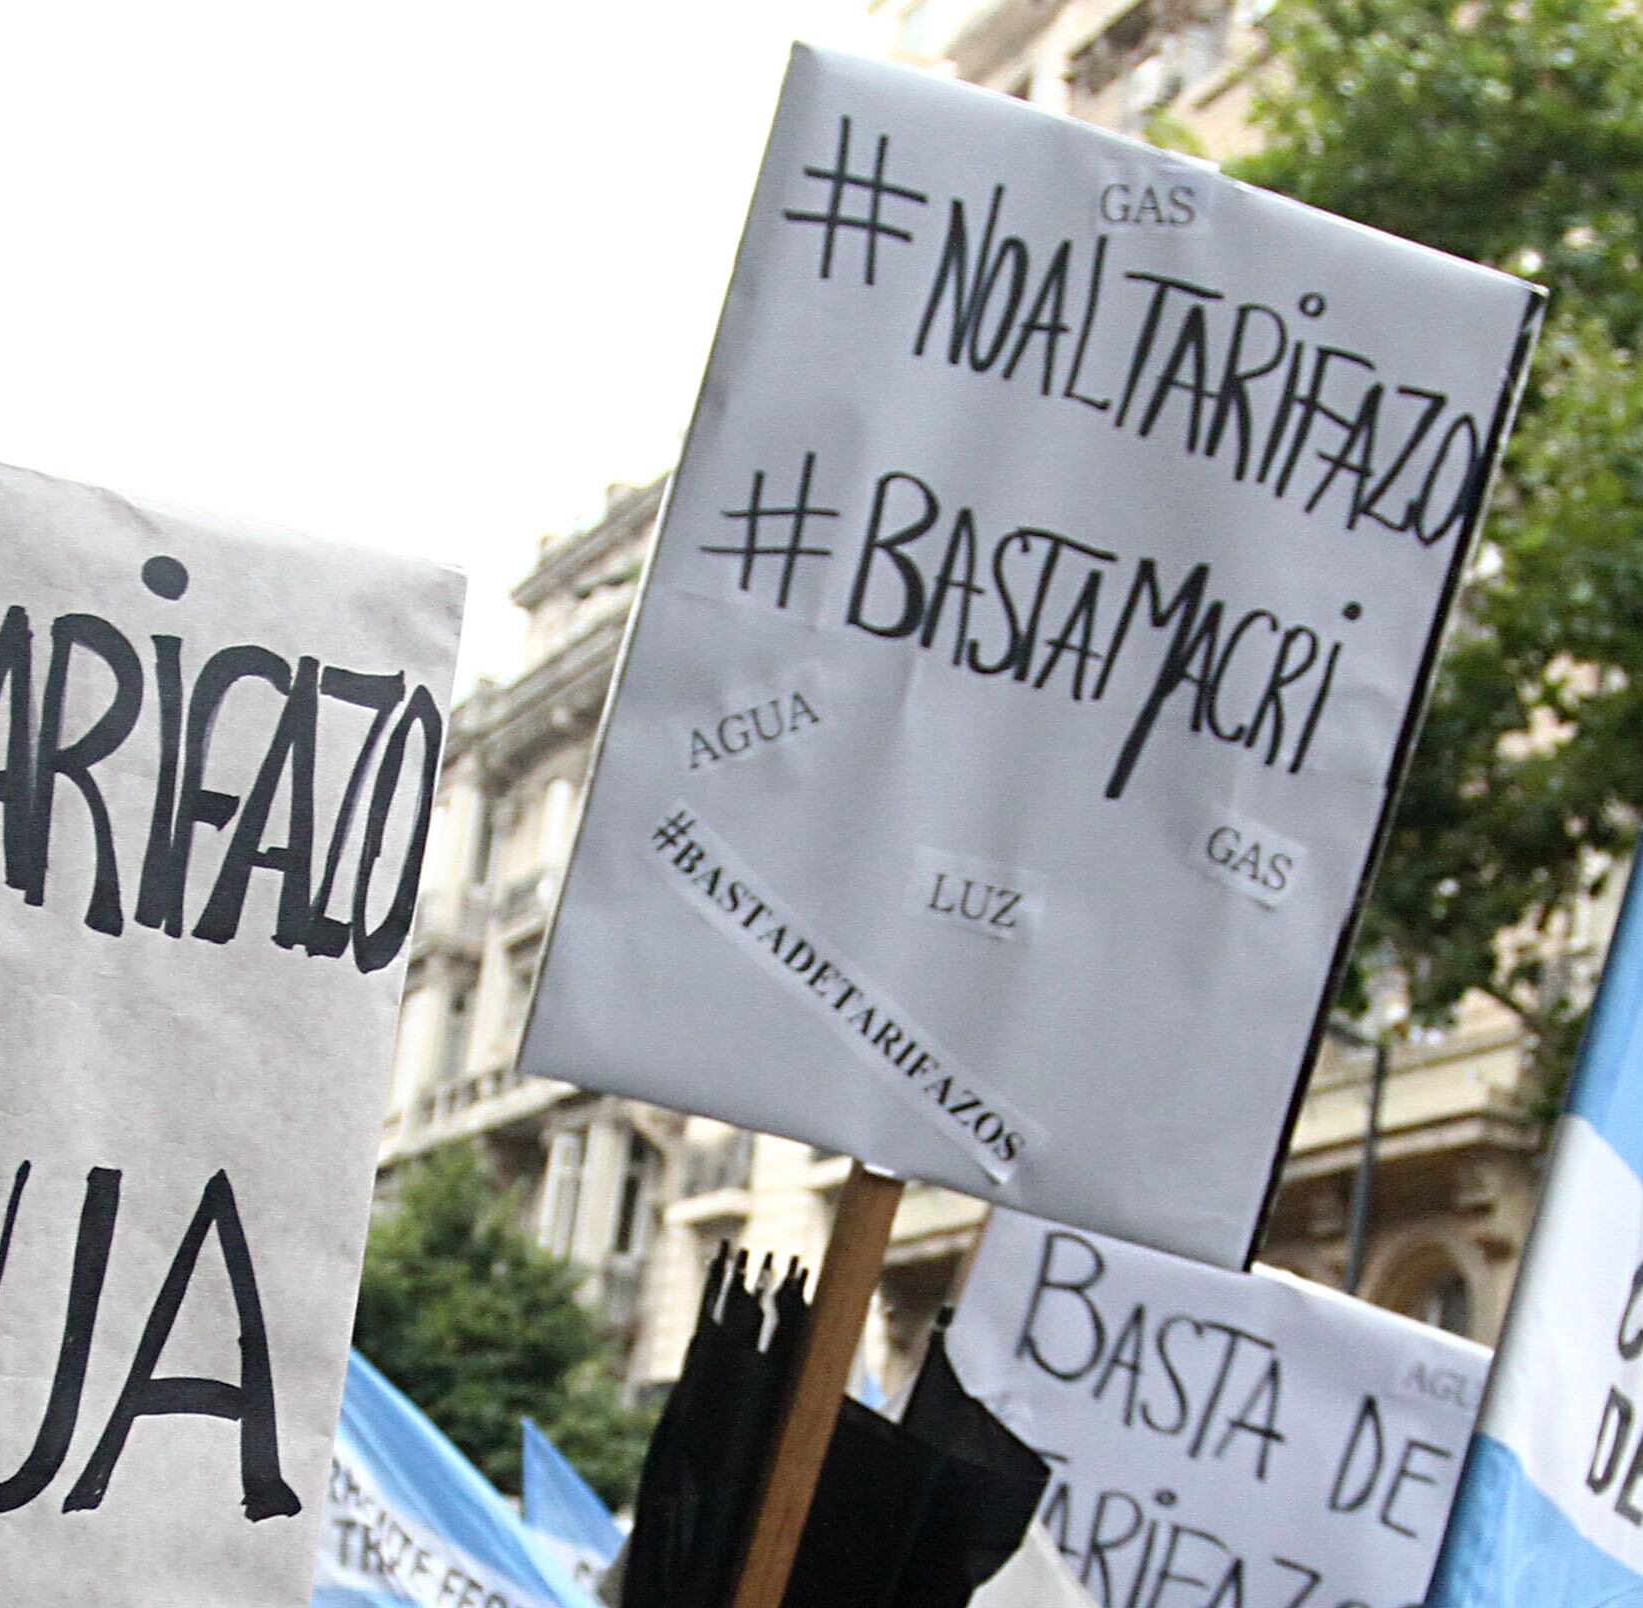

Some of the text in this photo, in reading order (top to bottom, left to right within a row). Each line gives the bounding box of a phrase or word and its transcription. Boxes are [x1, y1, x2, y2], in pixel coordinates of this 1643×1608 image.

[1099, 181, 1196, 230] GAS
[686, 690, 821, 771] AGUA
[1205, 825, 1294, 892] GAS
[928, 871, 1023, 932] LUZ
[651, 806, 1028, 1164] #BASTADETARIFAZOS
[1015, 1231, 1452, 1539] BASTA DE
